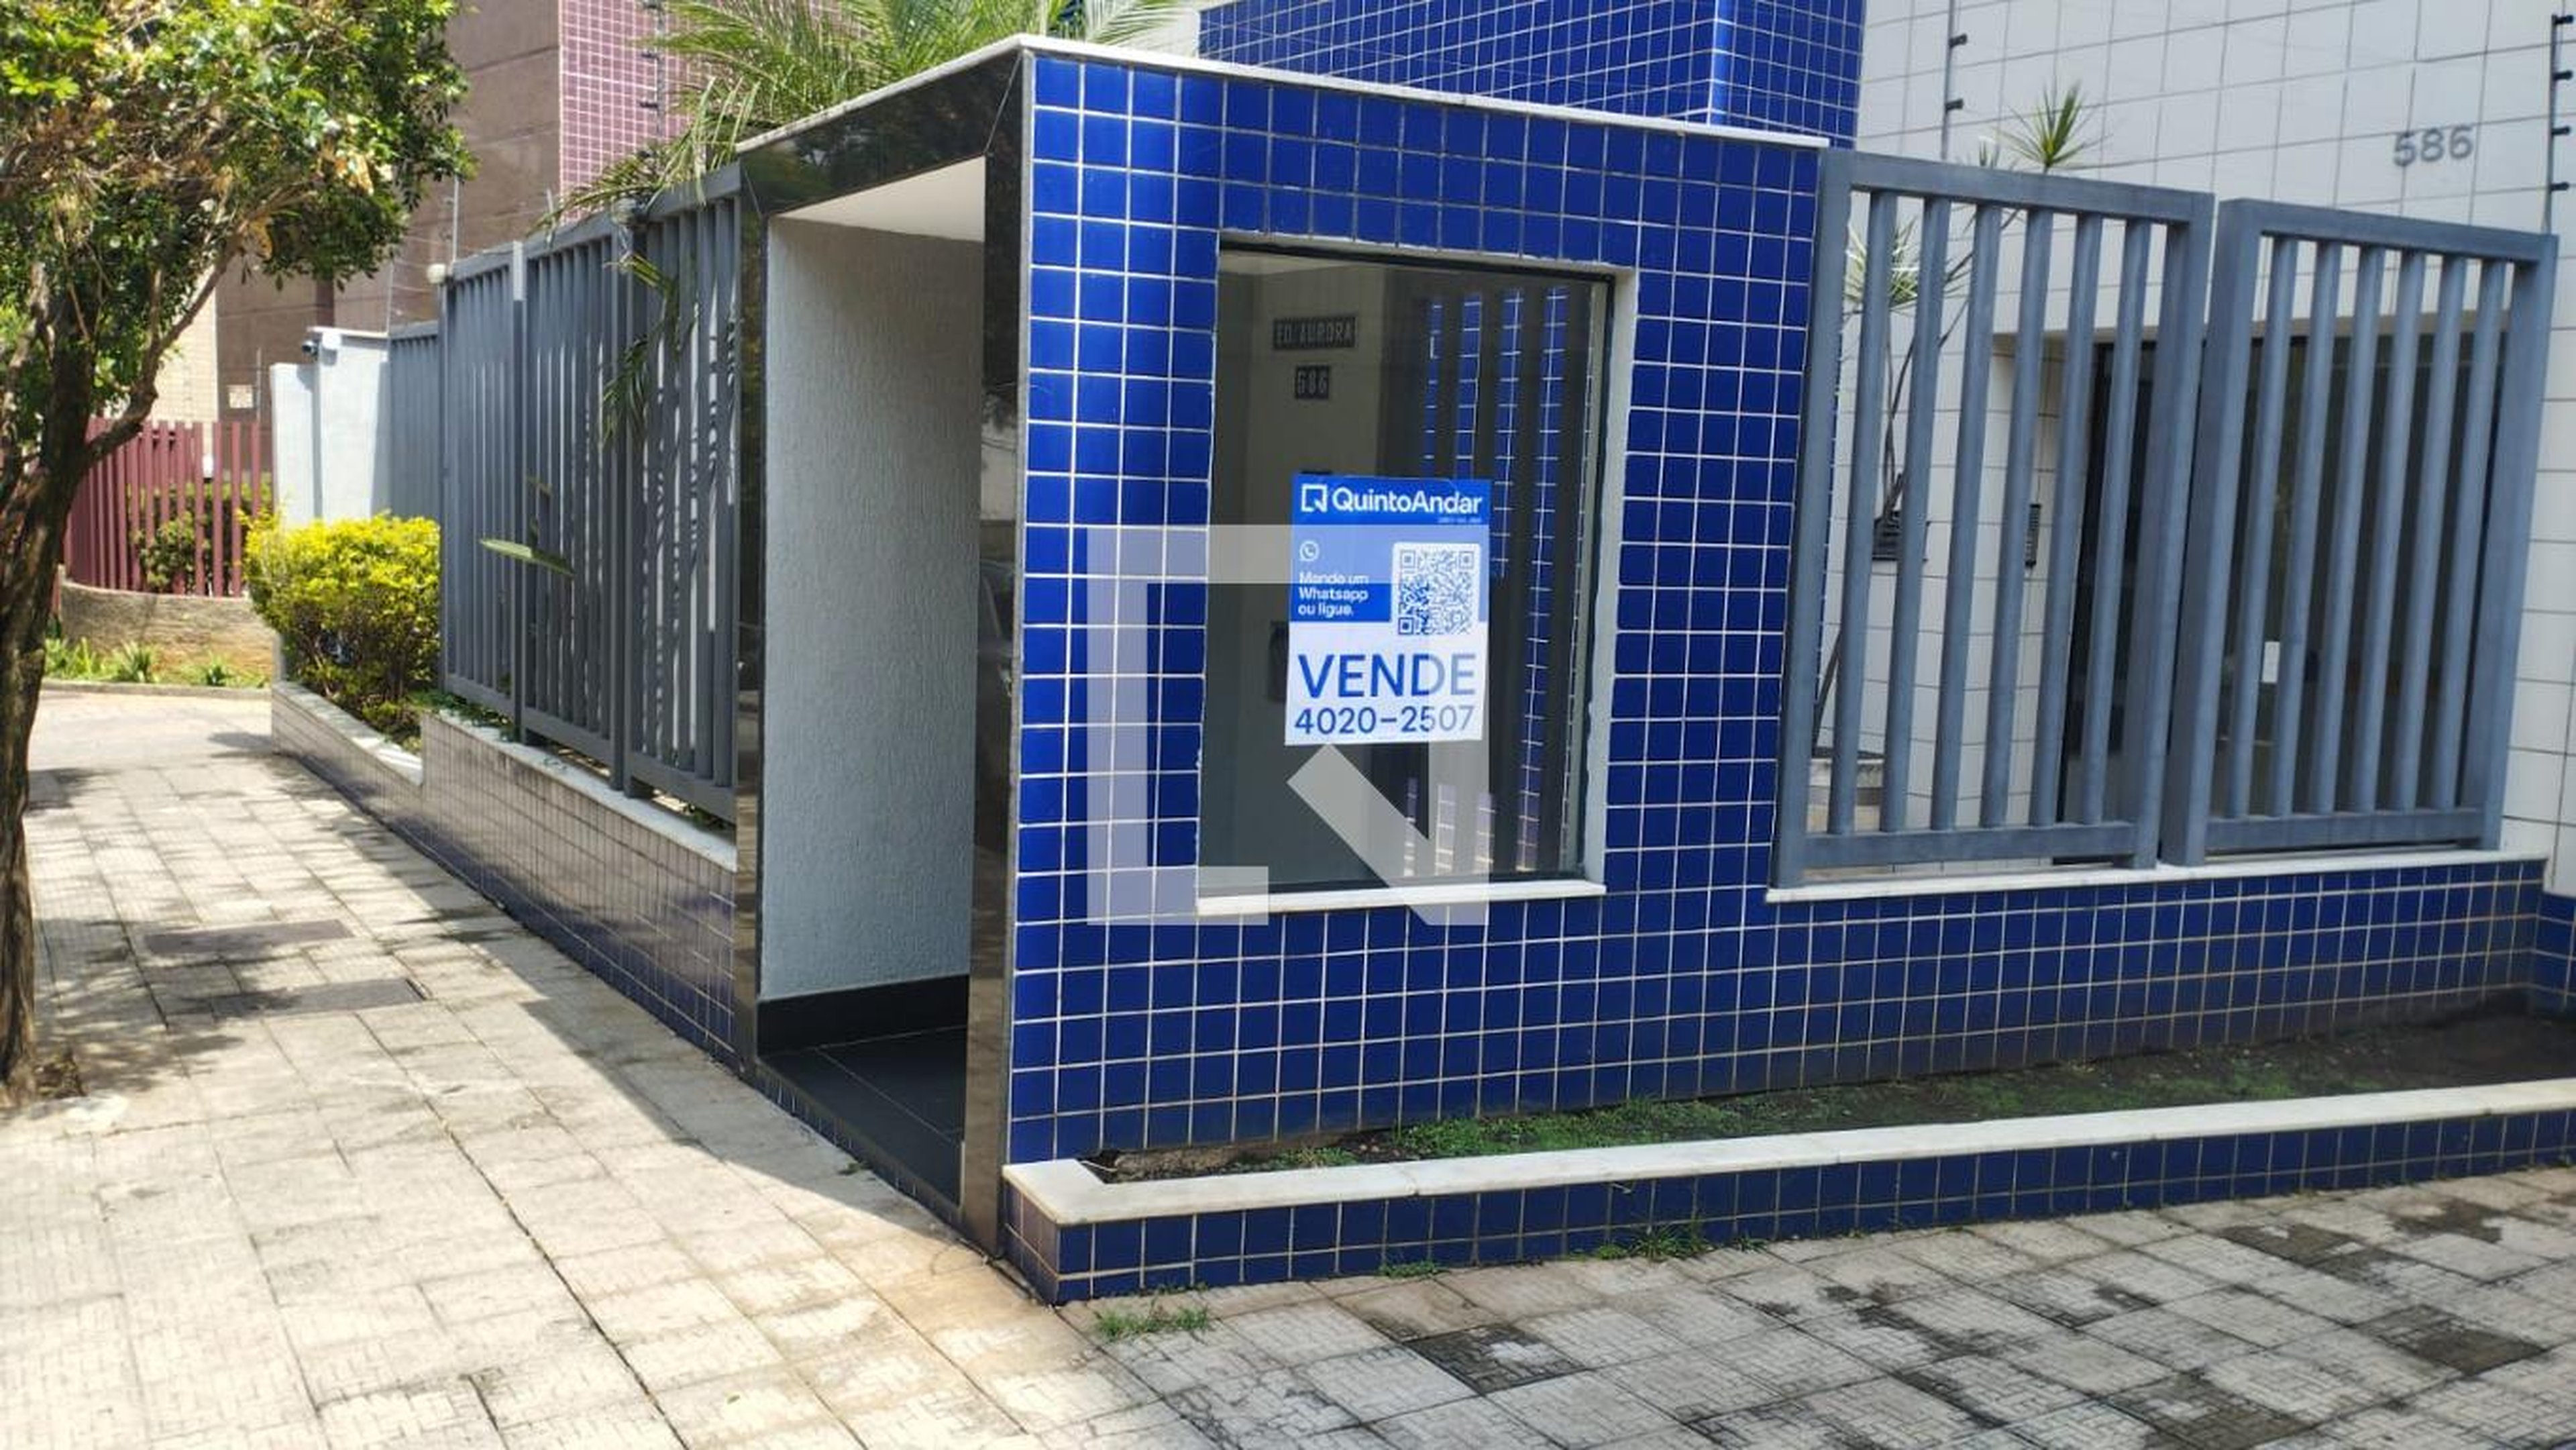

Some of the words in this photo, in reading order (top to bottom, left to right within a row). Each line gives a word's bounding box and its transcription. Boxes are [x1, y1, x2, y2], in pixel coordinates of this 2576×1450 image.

[2393, 125, 2473, 166] 586
[1299, 321, 1352, 343] AURORA
[1297, 370, 1328, 395] 586
[1332, 487, 1483, 515] QuintoAndar
[1348, 574, 1370, 584] um
[1299, 586, 1369, 603] Whatsapp
[1298, 605, 1316, 616] ou
[1299, 653, 1476, 698] VENDE
[1294, 705, 1475, 734] 4020-2507
